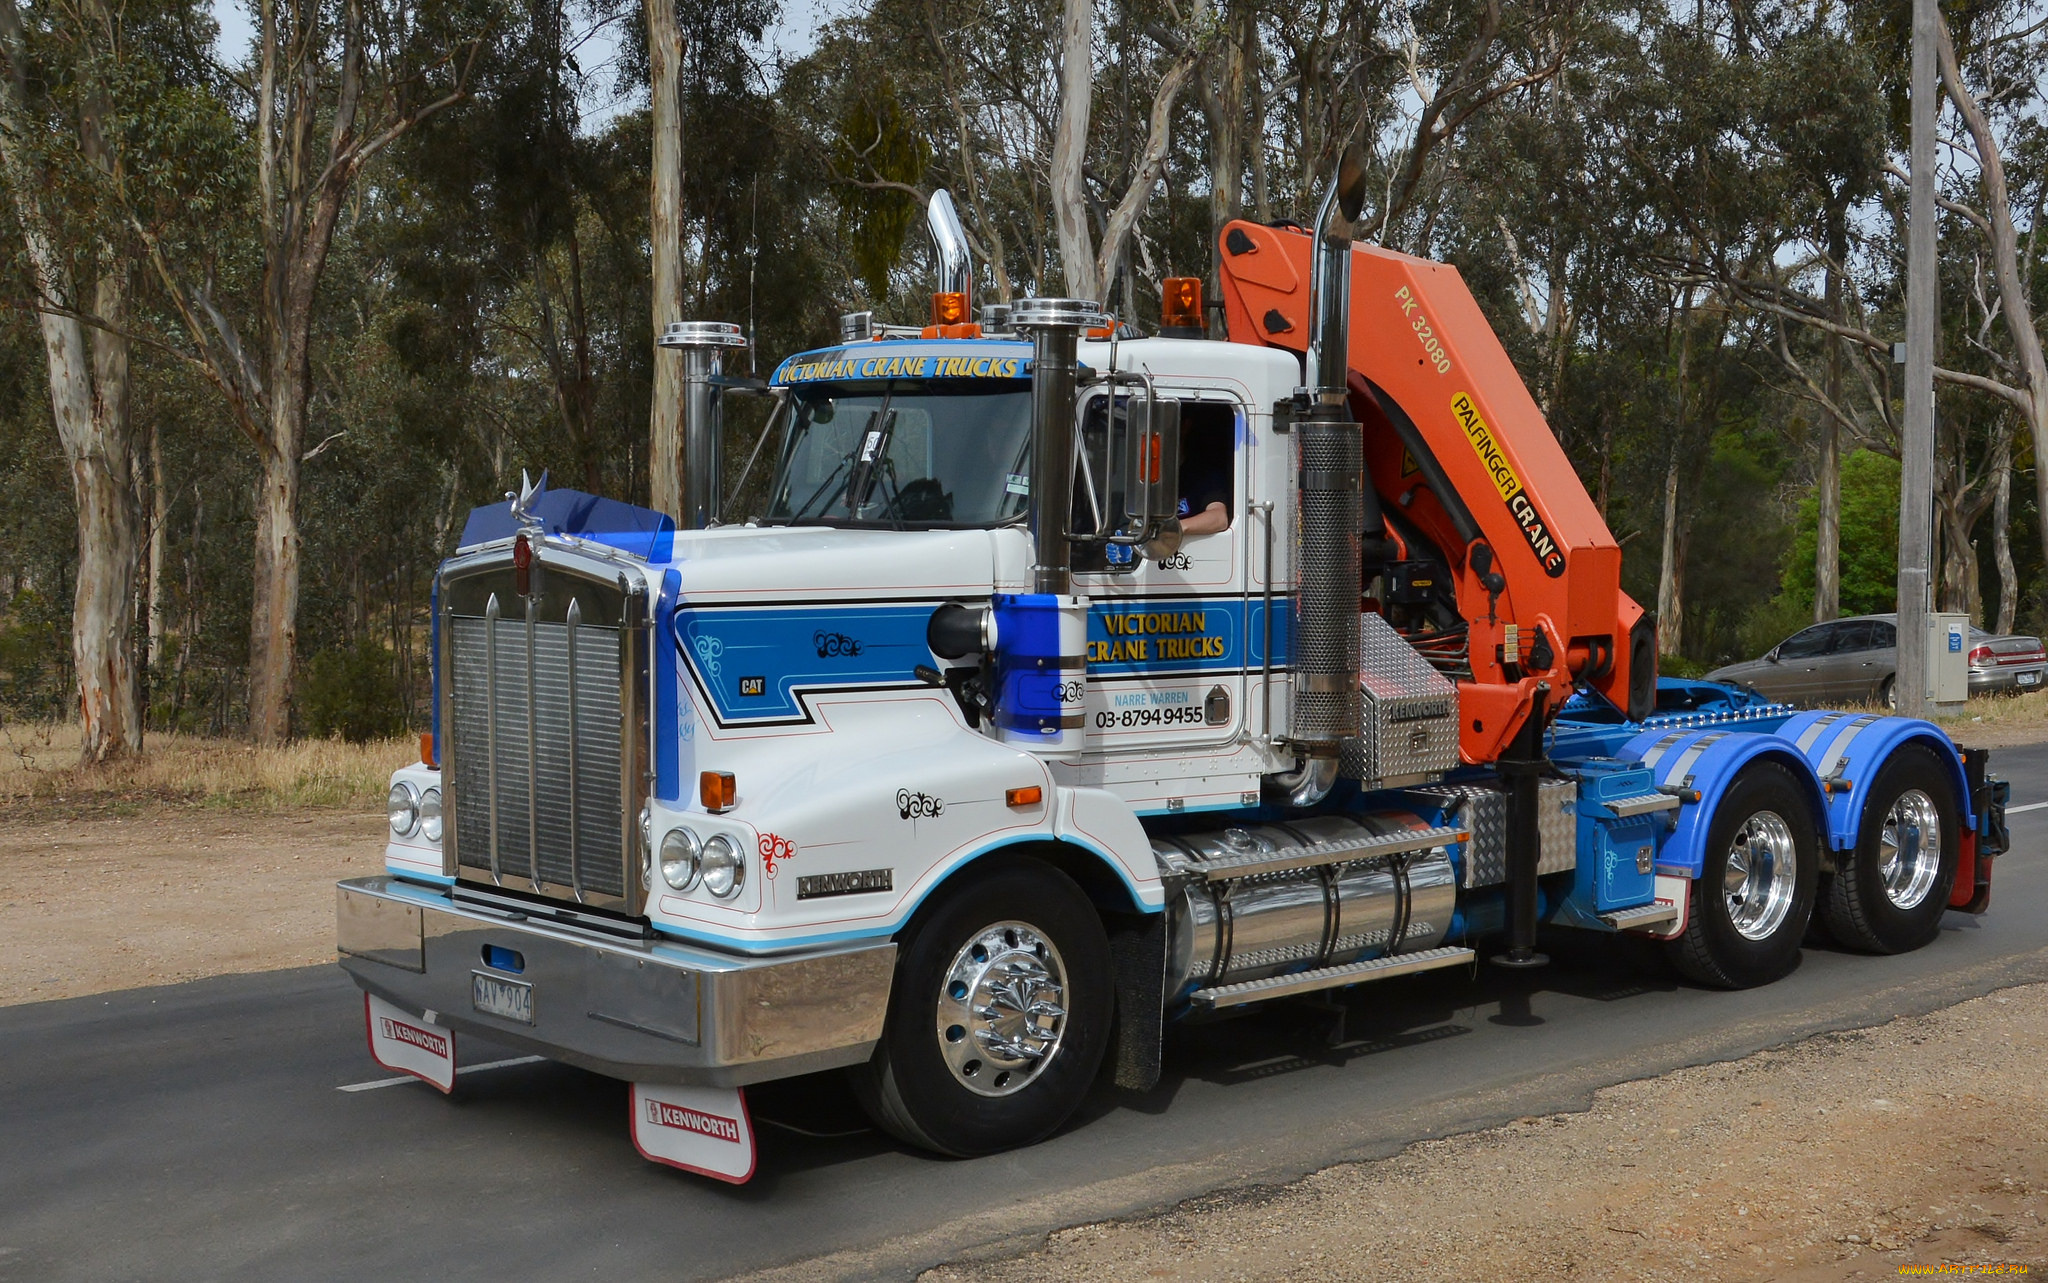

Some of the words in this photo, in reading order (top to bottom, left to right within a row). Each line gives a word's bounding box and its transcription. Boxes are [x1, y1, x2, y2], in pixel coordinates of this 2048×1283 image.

[1394, 285, 1418, 317] PK
[1412, 315, 1451, 375] 32080
[778, 359, 858, 384] VICTORIAN
[861, 357, 928, 377] CRANE
[933, 357, 1019, 378] TRUCKS
[1453, 396, 1517, 496] PALFINGER
[1512, 495, 1563, 571] CRANE
[1104, 612, 1206, 635] VICTORIAN
[1086, 638, 1148, 662] CRANE
[1156, 636, 1224, 659] TRUCKS
[741, 679, 763, 694] CAT
[1114, 693, 1146, 707] NARRE
[1150, 691, 1189, 705] WARREN
[1096, 708, 1162, 729] 03-8794
[1163, 706, 1203, 725] 9455
[1391, 700, 1449, 720] KENWORTH
[799, 869, 893, 896] KENWORTH
[394, 1022, 446, 1056] KENWORTH
[662, 1106, 738, 1139] KENWORTH
